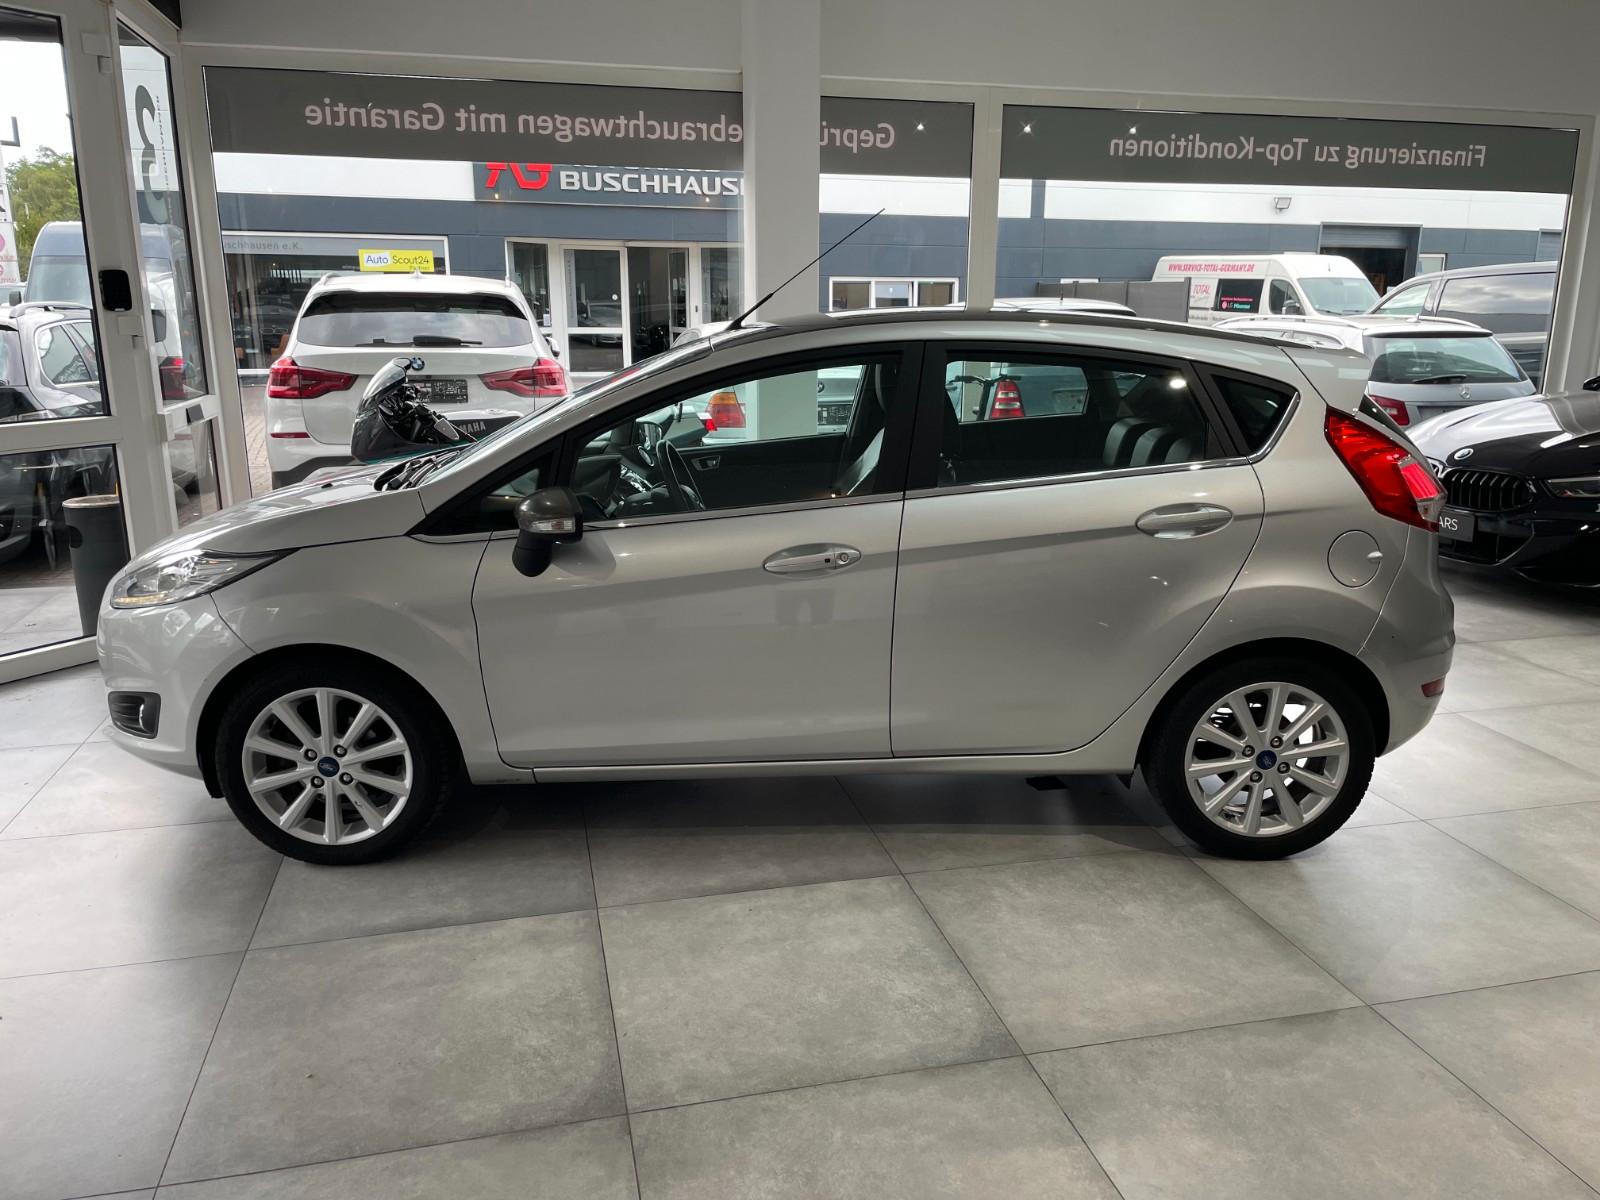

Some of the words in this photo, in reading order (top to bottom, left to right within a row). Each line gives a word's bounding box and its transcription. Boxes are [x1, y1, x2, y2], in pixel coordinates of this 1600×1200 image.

[560, 170, 743, 196] BUSCHHAUS
[224, 240, 279, 249] schhausen
[366, 255, 389, 264] Auto
[392, 255, 429, 265] Scout24
[1192, 284, 1211, 295] TOTAL
[459, 421, 486, 433] MAHA
[1439, 515, 1458, 531] ARS
